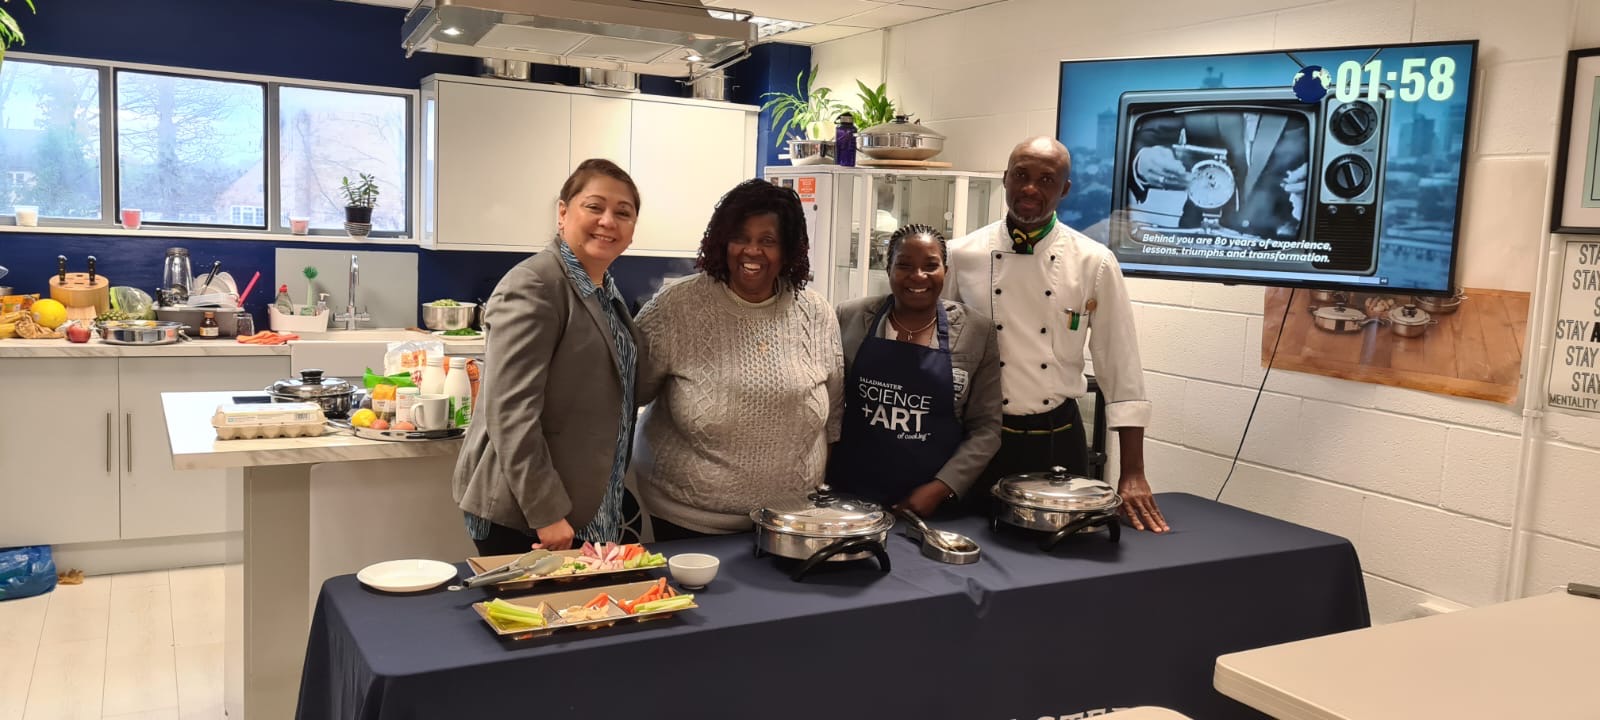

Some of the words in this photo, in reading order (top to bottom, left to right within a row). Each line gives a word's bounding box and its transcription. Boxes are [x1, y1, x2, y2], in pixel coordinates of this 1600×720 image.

[1335, 56, 1456, 103] 01:58
[1142, 233, 1175, 244] Behind
[1177, 236, 1194, 246] you
[1196, 237, 1212, 245] are
[1214, 237, 1227, 246] 80
[1229, 239, 1257, 249] years
[1259, 239, 1270, 249] of
[1271, 240, 1332, 251] experience,
[1142, 245, 1180, 255] lessons,
[1182, 247, 1224, 258] triumphs
[1226, 249, 1246, 259] and
[1249, 251, 1330, 263] transformation.
[1556, 319, 1589, 341] STAY
[1566, 346, 1599, 367] STAY
[859, 384, 933, 409] SCIENCE
[1549, 394, 1598, 409] MENTALITY
